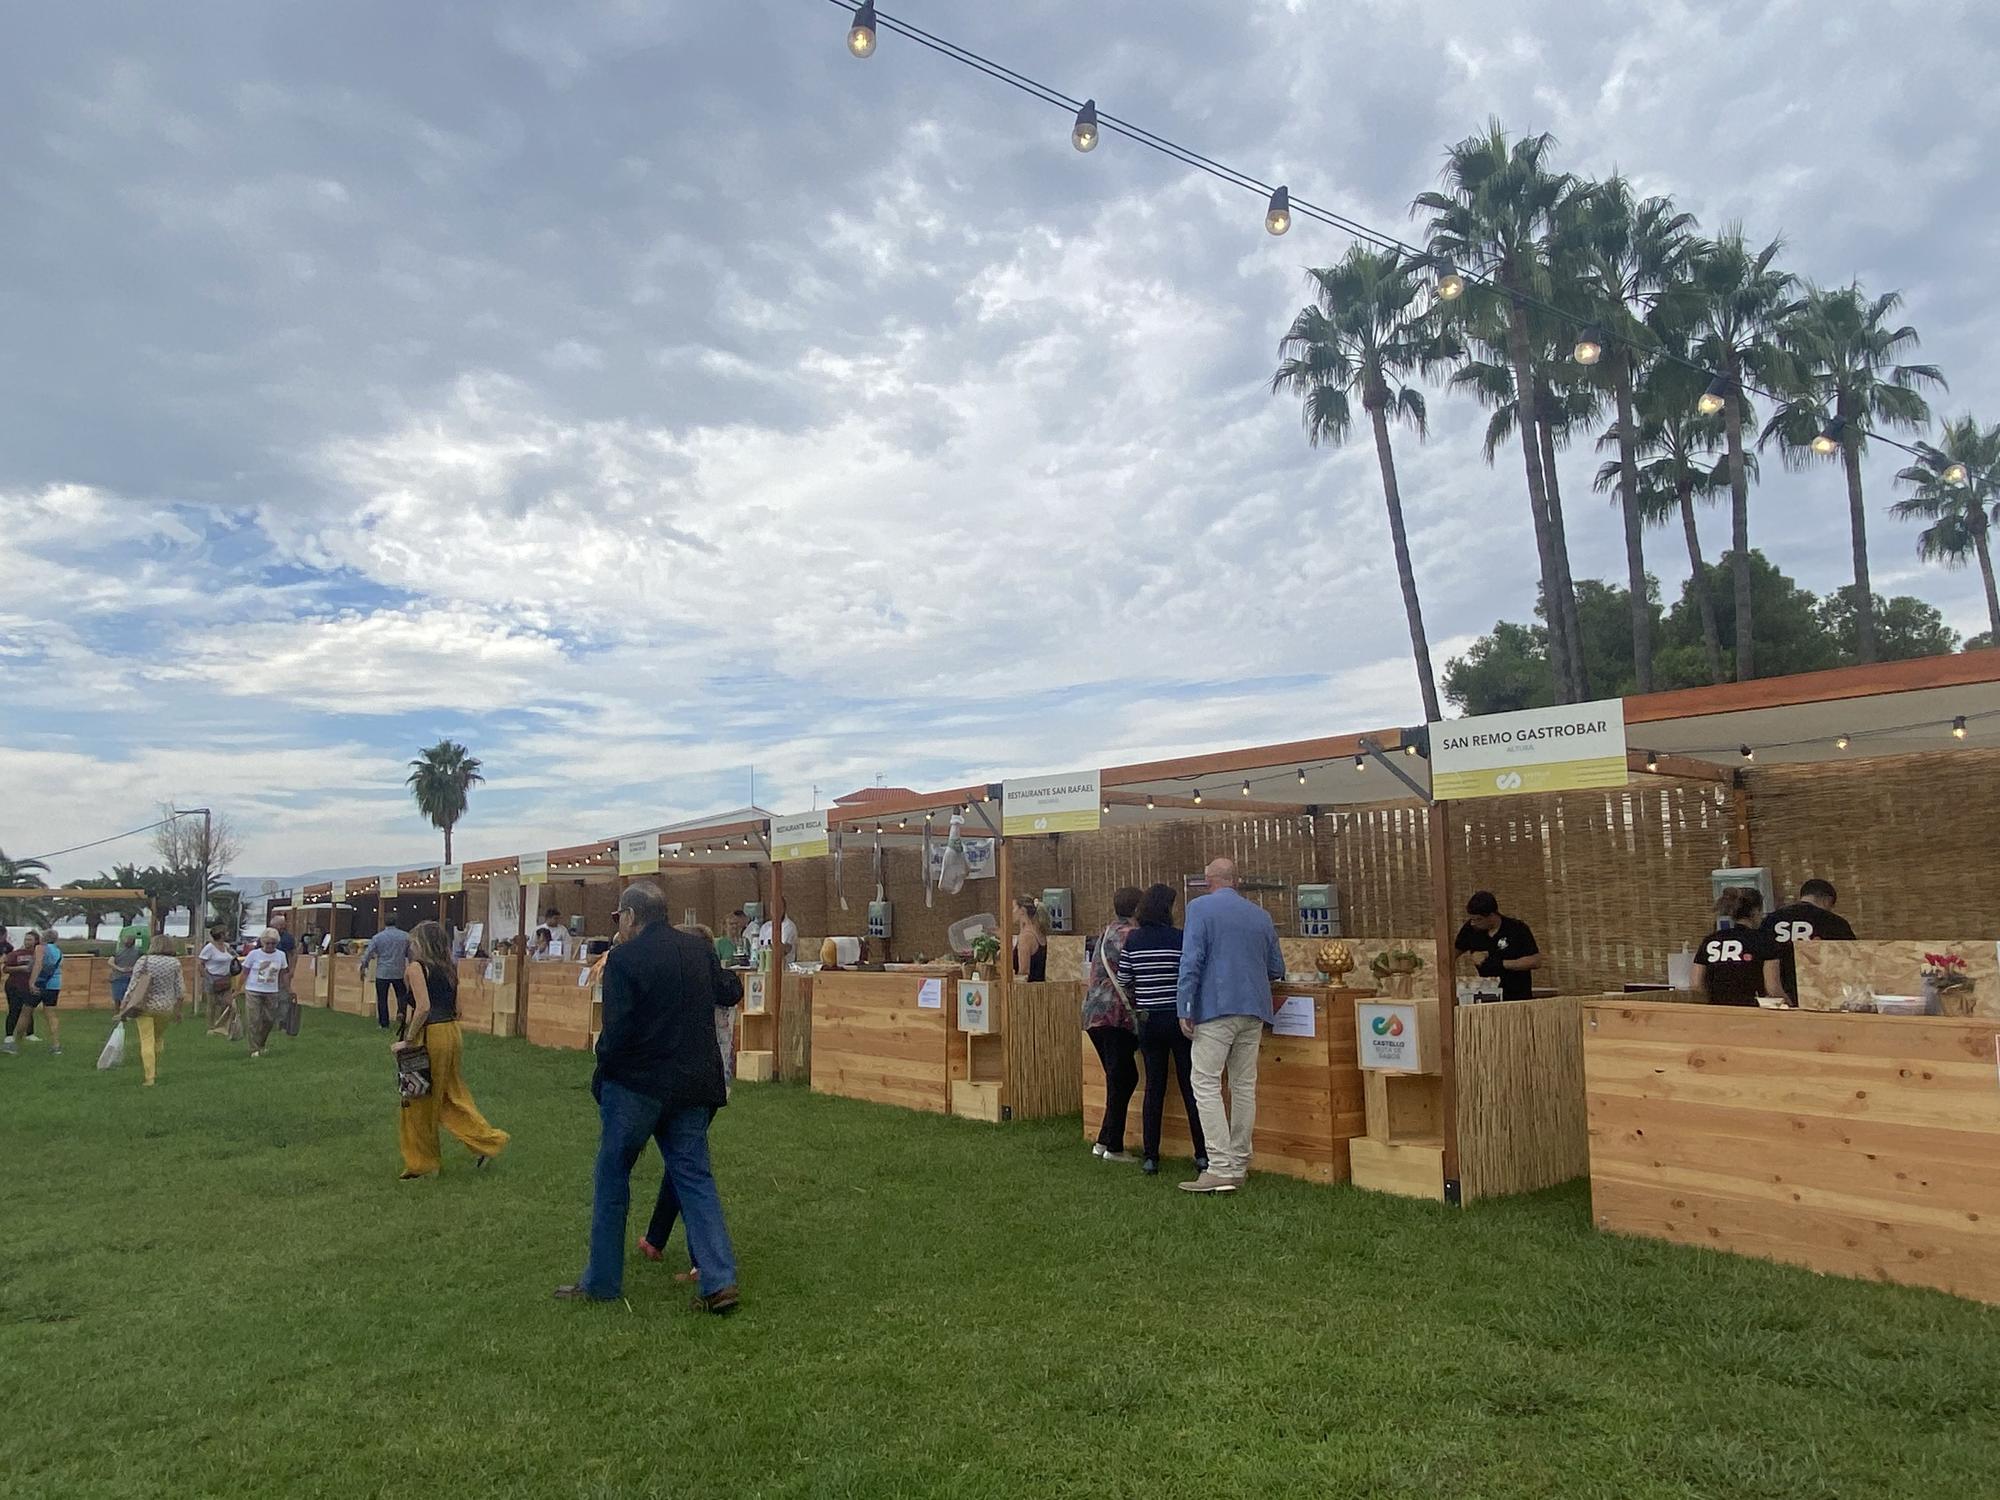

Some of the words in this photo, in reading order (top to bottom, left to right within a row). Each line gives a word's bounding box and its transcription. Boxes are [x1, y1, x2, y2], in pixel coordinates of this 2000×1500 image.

[1443, 737, 1469, 750] SAN
[1472, 731, 1512, 747] REMO
[1516, 720, 1607, 741] GASTROBAR
[1007, 788, 1050, 800] RESTAURANTE
[1052, 786, 1067, 796] SAN
[1068, 784, 1095, 794] RAFAEL
